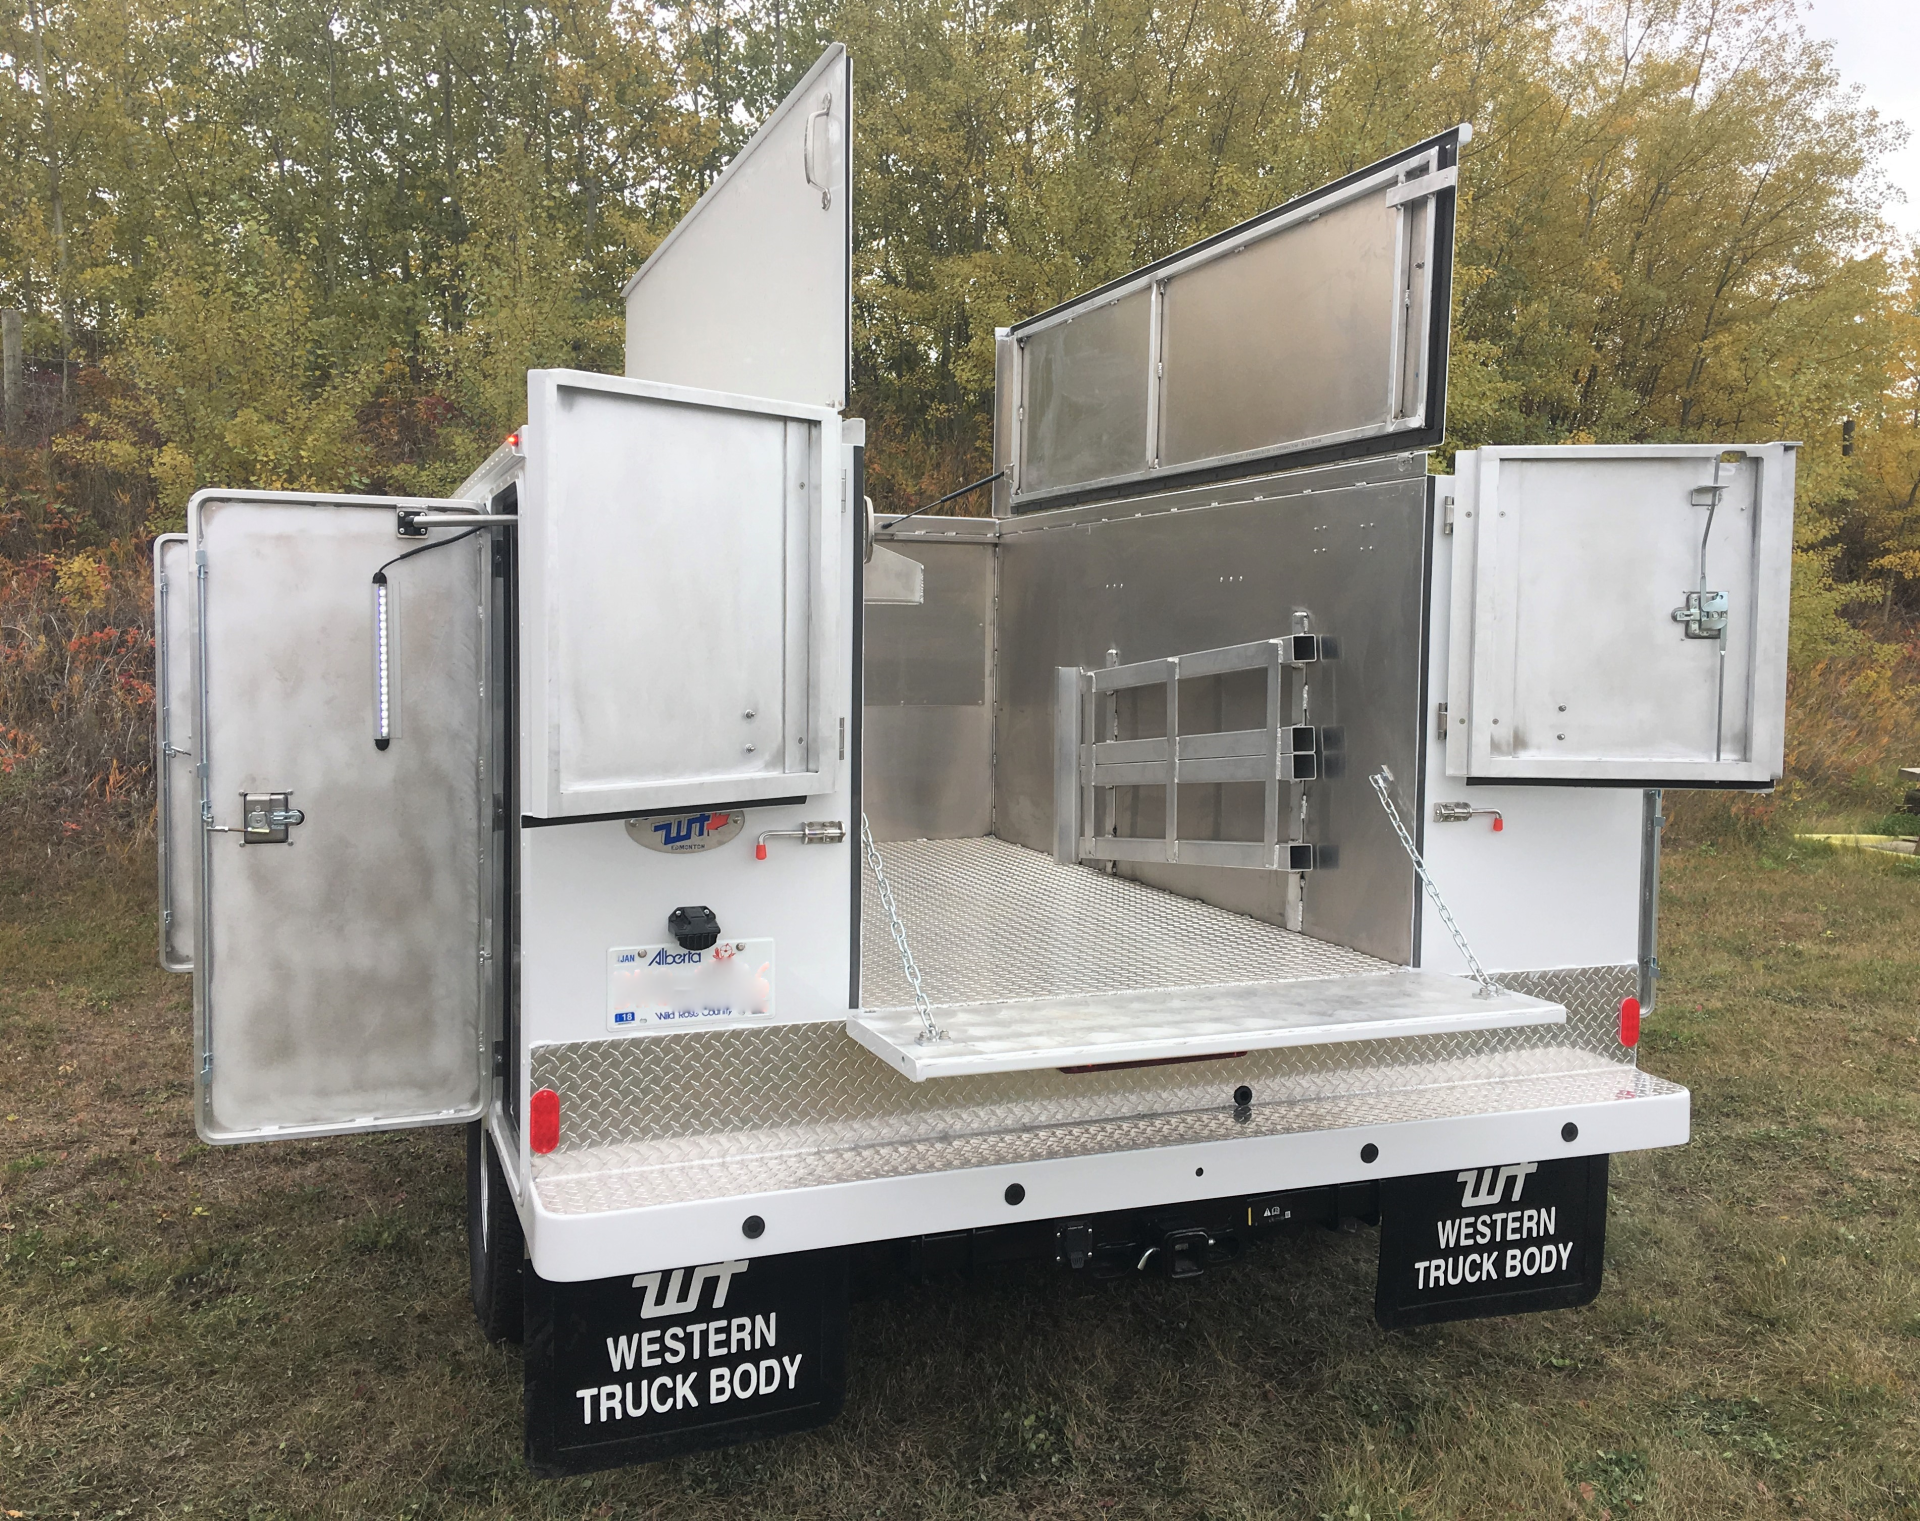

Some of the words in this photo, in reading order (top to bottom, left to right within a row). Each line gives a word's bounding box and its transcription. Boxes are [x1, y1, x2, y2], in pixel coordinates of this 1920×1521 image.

[620, 954, 635, 963] JAN
[647, 947, 702, 966] Alberta
[622, 1013, 633, 1021] 18
[655, 1011, 676, 1021] Wild
[1437, 1206, 1556, 1249] WESTERN
[1414, 1251, 1499, 1290] TRUCK
[1505, 1241, 1574, 1278] BODY
[606, 1312, 777, 1373] WESTERN
[576, 1371, 699, 1425] TRUCK
[710, 1354, 803, 1405] BODY
